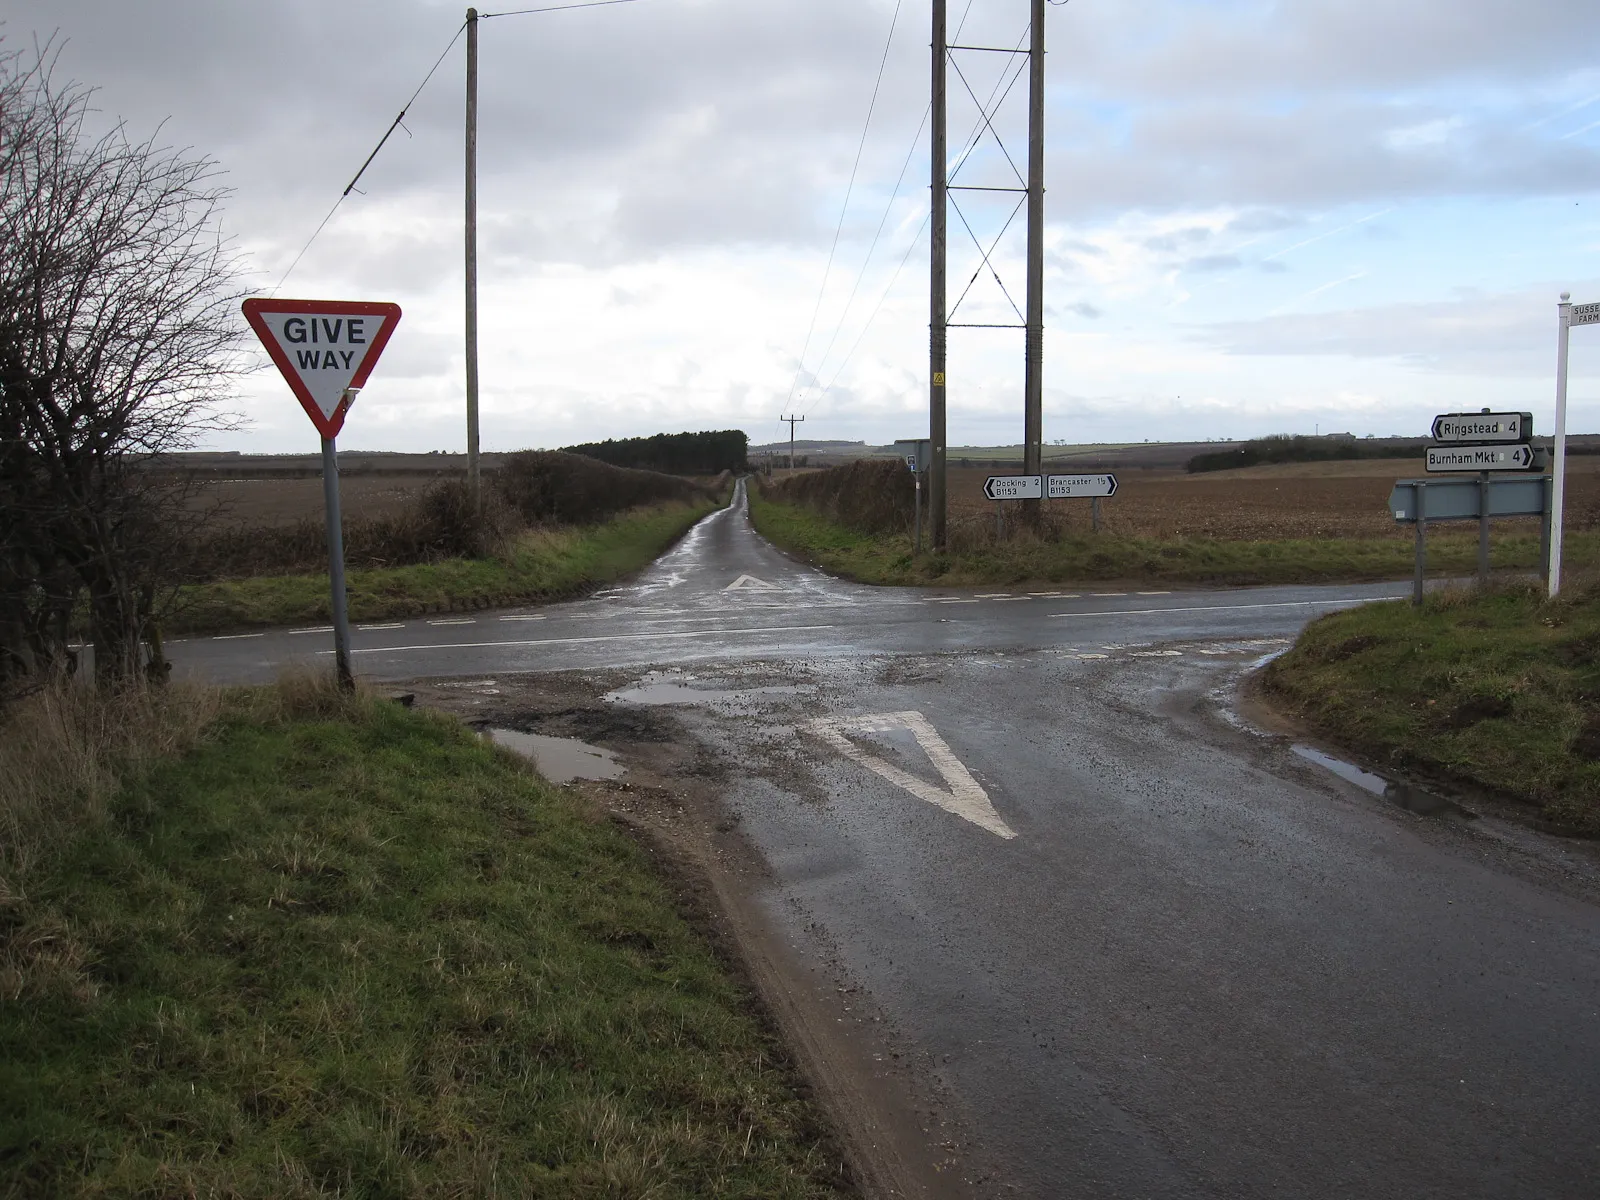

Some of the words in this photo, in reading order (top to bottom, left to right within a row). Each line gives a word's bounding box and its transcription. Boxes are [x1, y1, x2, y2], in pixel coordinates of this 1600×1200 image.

[1578, 313, 1599, 323] FARM
[283, 317, 366, 344] GIVE
[296, 350, 355, 370] WAY
[1444, 422, 1499, 436] Ringstead
[1508, 421, 1516, 433] 4
[1429, 453, 1472, 464] Burnham
[1475, 451, 1498, 463] Mkt.
[1512, 450, 1520, 462] 4
[1034, 478, 1040, 486] 2
[996, 488, 1017, 496] B1153
